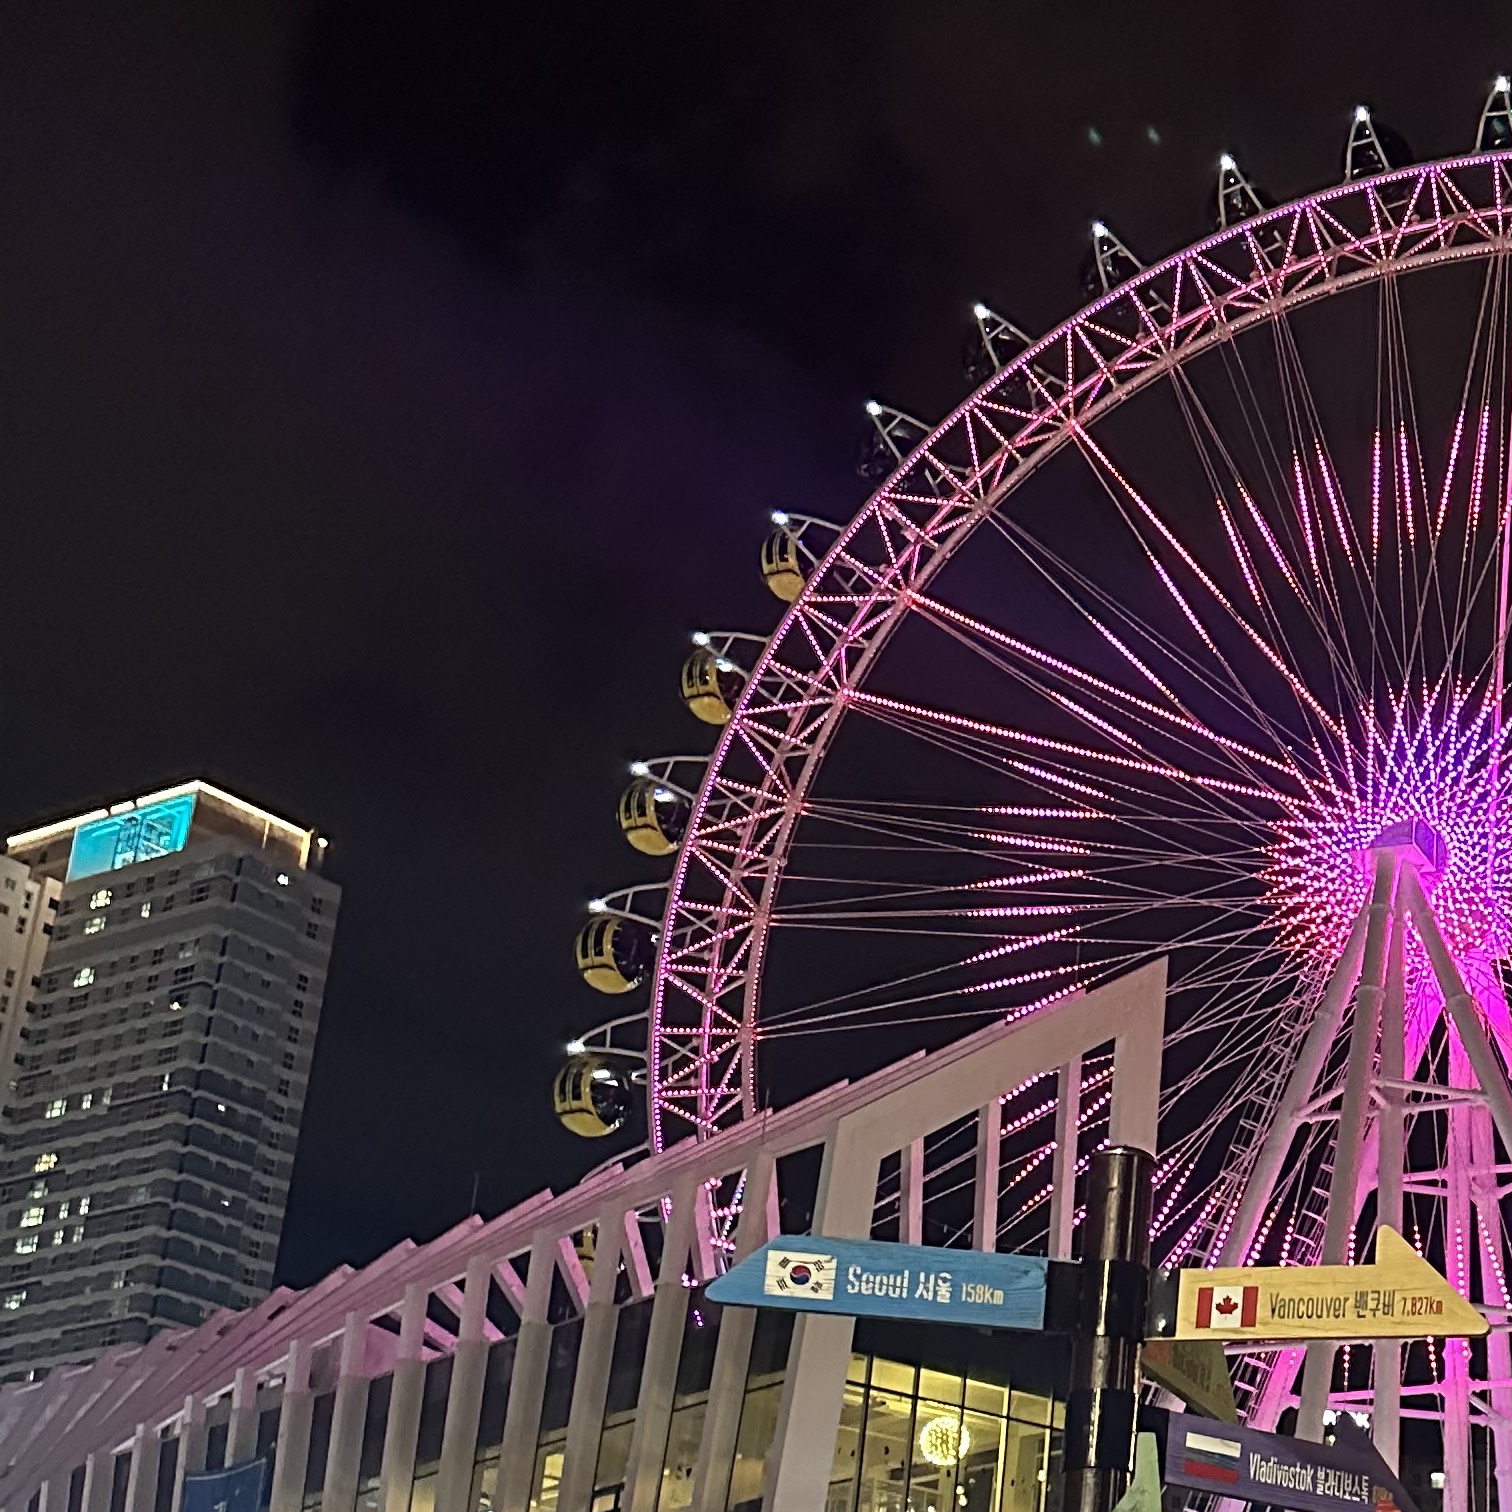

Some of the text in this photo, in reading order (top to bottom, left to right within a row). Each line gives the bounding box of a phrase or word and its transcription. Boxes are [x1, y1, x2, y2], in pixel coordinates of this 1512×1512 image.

[846, 1264, 909, 1299] Seoul
[914, 1271, 954, 1304] 서울
[1268, 1291, 1349, 1321] Vancouver
[1248, 1452, 1315, 1492] Vladivostok
